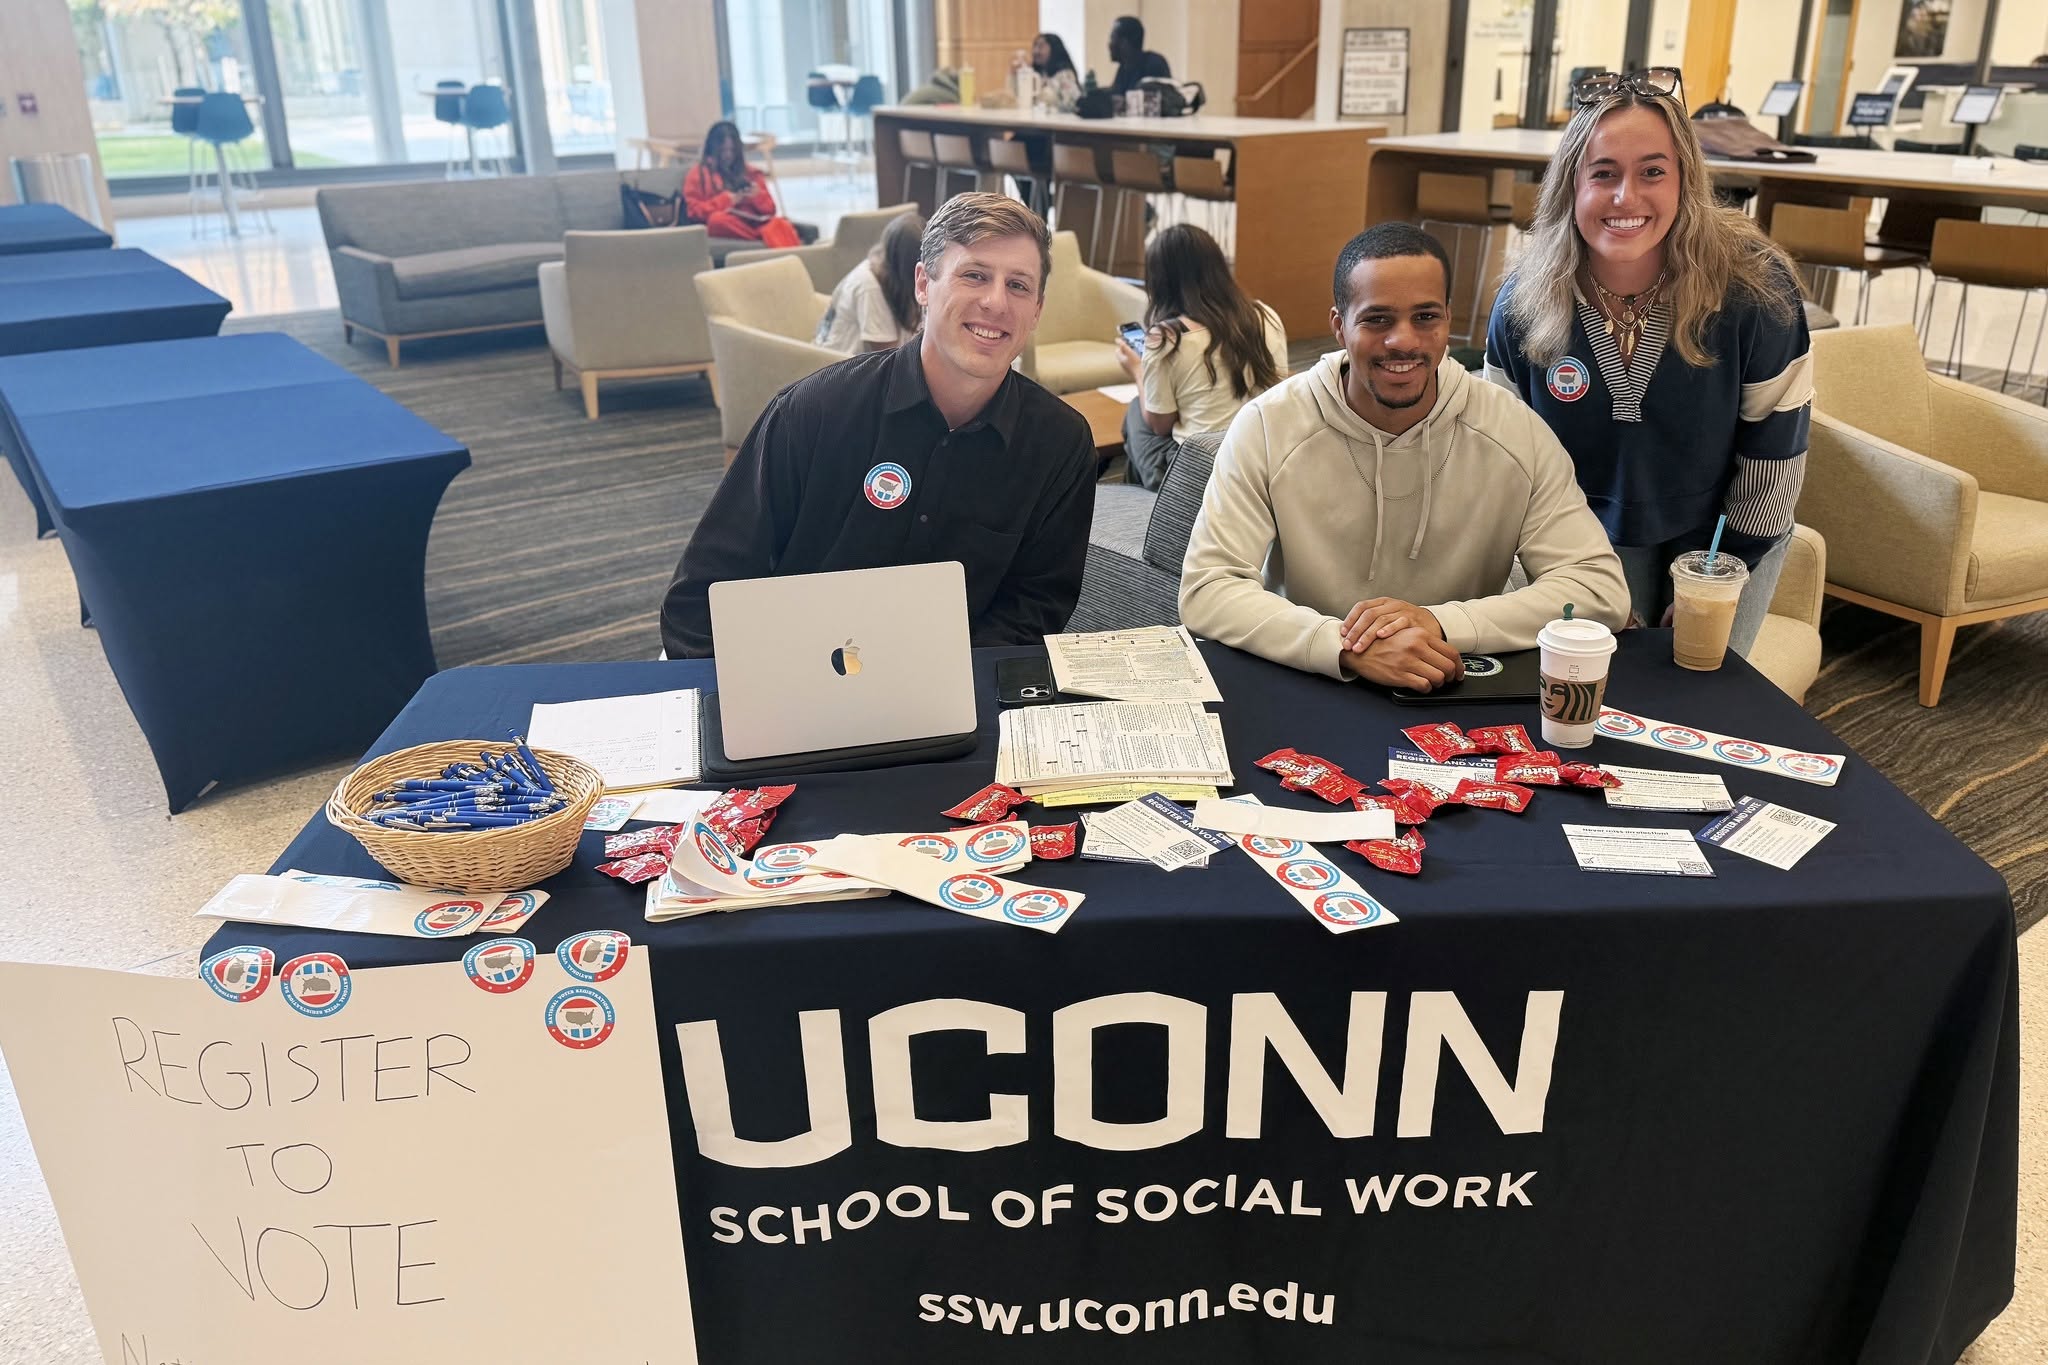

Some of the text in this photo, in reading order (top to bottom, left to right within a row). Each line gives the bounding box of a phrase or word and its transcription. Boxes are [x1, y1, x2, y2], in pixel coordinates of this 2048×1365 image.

[1146, 798, 1183, 821] REGISTER
[1199, 829, 1222, 846] VOTE
[1735, 811, 1749, 825] AND
[1744, 801, 1762, 817] VOTE
[557, 989, 575, 1000] VOTER
[112, 1016, 477, 1111] REGISTER
[676, 991, 1565, 1168] UCONN
[227, 1143, 333, 1195] TO
[711, 1172, 1538, 1246] SCHOOL OF SOCIAL WORK
[191, 1217, 446, 1311] VOTE
[919, 1281, 1335, 1336] ssw.uconn.edu
